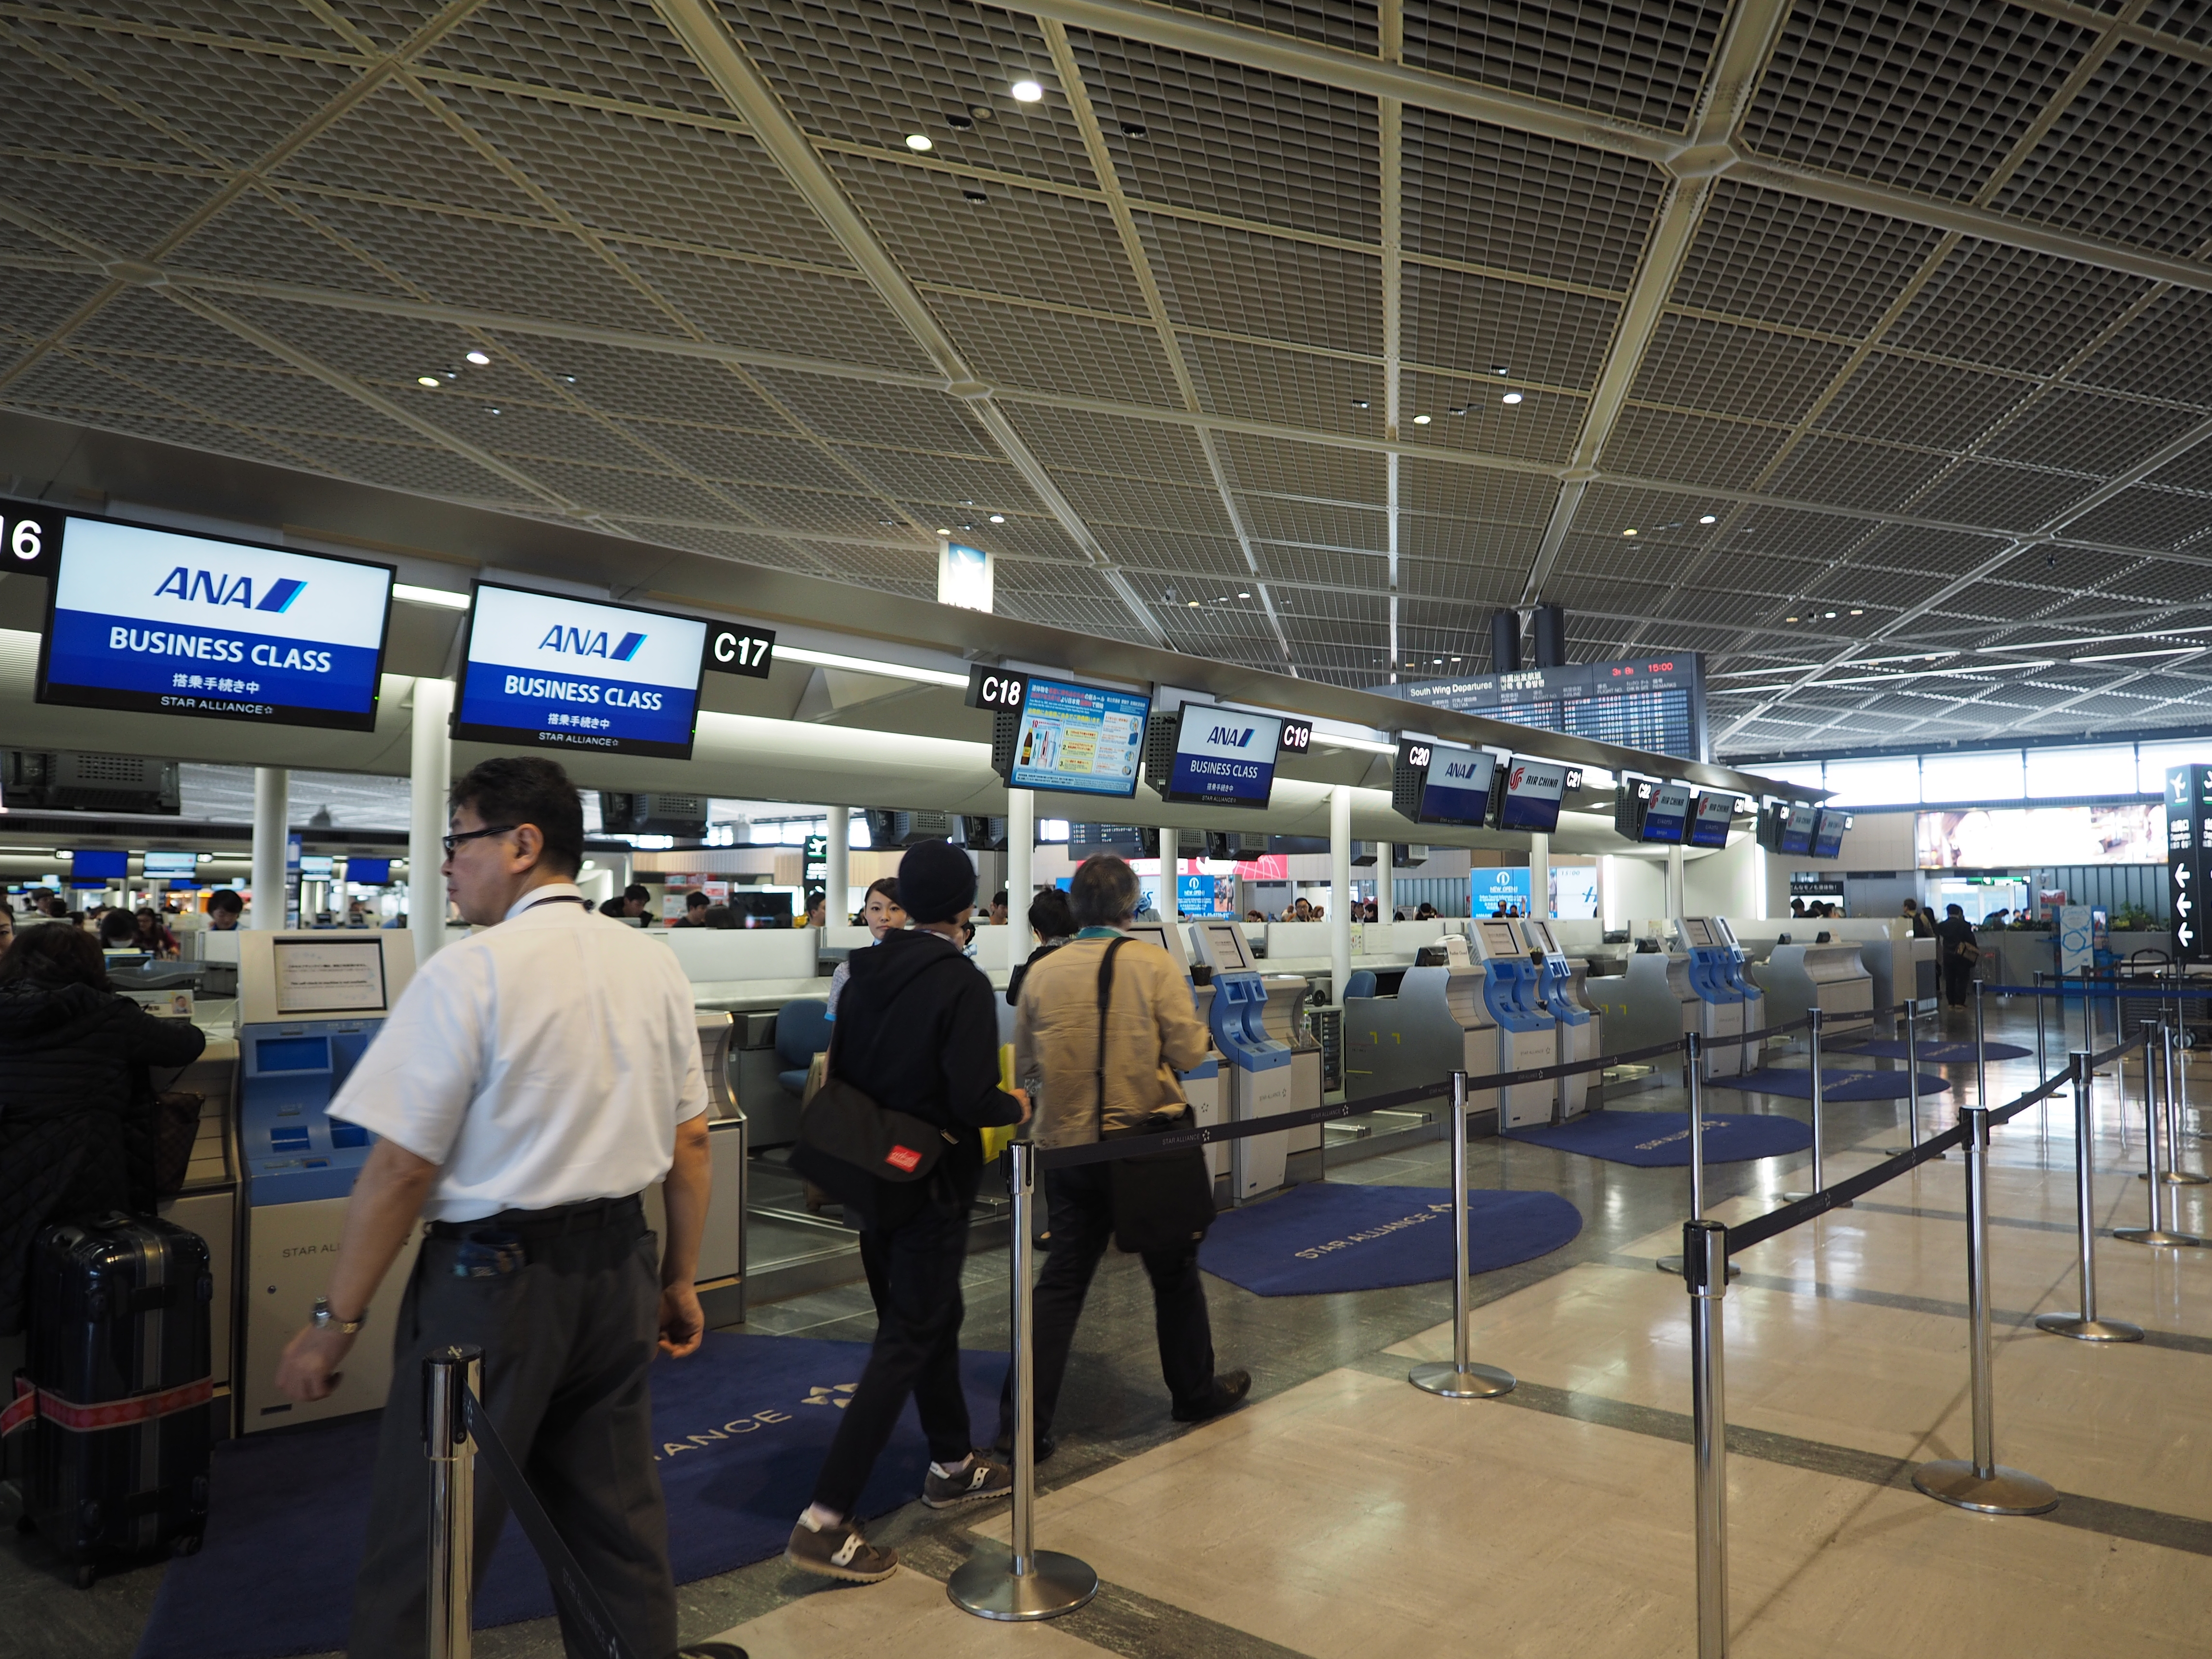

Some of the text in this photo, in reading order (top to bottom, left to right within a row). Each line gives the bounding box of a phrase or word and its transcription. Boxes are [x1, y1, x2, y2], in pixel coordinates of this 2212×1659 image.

[154, 566, 252, 609] ANA
[109, 626, 332, 673] BUSINESS CLASS
[538, 624, 609, 658] ANA
[714, 632, 769, 667] C17
[172, 673, 260, 695] 搭乗手続き中
[505, 674, 663, 711] BUSINESS CLASS
[983, 676, 1021, 706] C18
[1410, 682, 1492, 697] South Wing Departures
[160, 696, 263, 715] STAR ALLIANCE
[548, 712, 610, 731] 搭乗手続き中
[539, 732, 612, 746] STAR ALLIANCE
[1207, 726, 1238, 746] ANA
[1284, 724, 1309, 747] C19
[1409, 745, 1430, 767] C20
[1190, 759, 1258, 778] BUSINESS CLASS
[1445, 762, 1467, 779] ANA
[1526, 775, 1559, 788] AIR CHINA
[1566, 770, 1582, 788] C21
[1661, 796, 1684, 807] AIR CHINA
[1322, 1108, 1341, 1118] ALLIANCE
[1177, 1133, 1200, 1144] ALLIANCE
[1295, 1213, 1437, 1259] STAR ALLIANCE
[282, 1246, 317, 1259] STAR
[654, 1409, 792, 1461] ANCE
